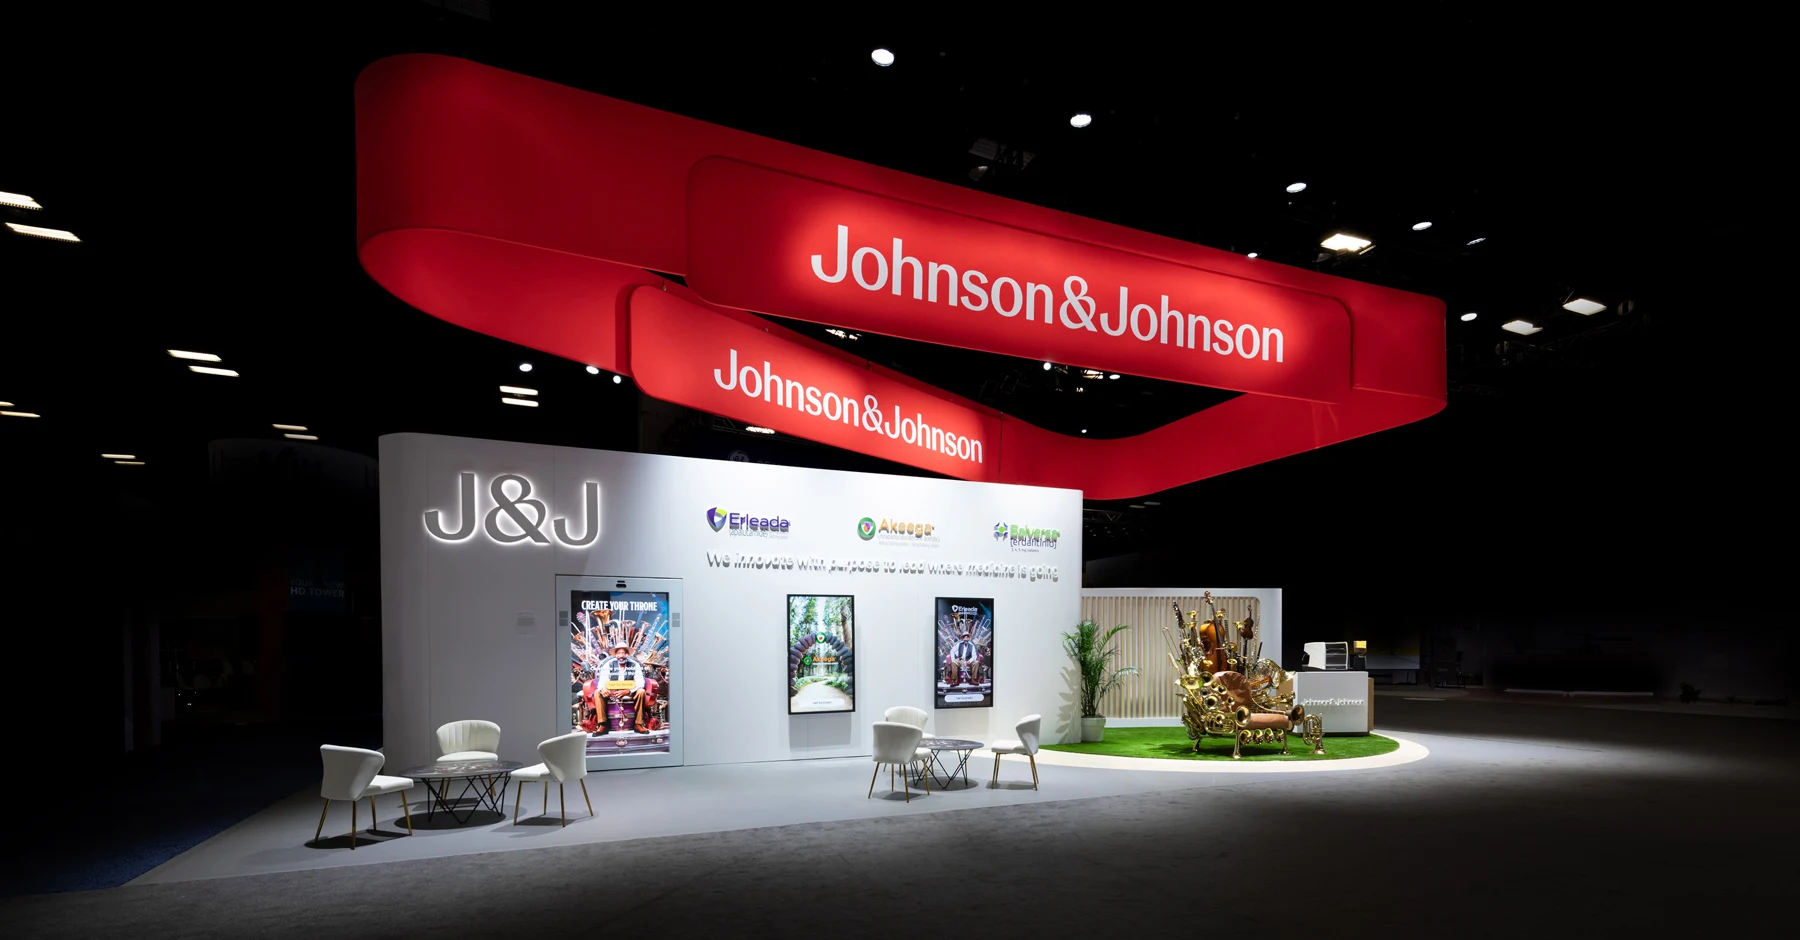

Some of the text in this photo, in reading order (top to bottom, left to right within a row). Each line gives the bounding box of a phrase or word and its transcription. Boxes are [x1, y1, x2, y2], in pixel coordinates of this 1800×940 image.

[811, 224, 1284, 363] Johnson&Johnson
[714, 348, 983, 463] Johnson&Johnson
[424, 472, 600, 547] J&J
[729, 512, 790, 531] Erleada
[879, 518, 932, 537] Akeega
[706, 551, 730, 568] We
[734, 553, 794, 570] innovate
[828, 559, 880, 574] purpose
[1030, 565, 1059, 582] going
[309, 588, 345, 598] TOWER
[581, 600, 658, 612] CREATE YOUR THRONE
[1301, 698, 1365, 706] Johnson&Johnson
